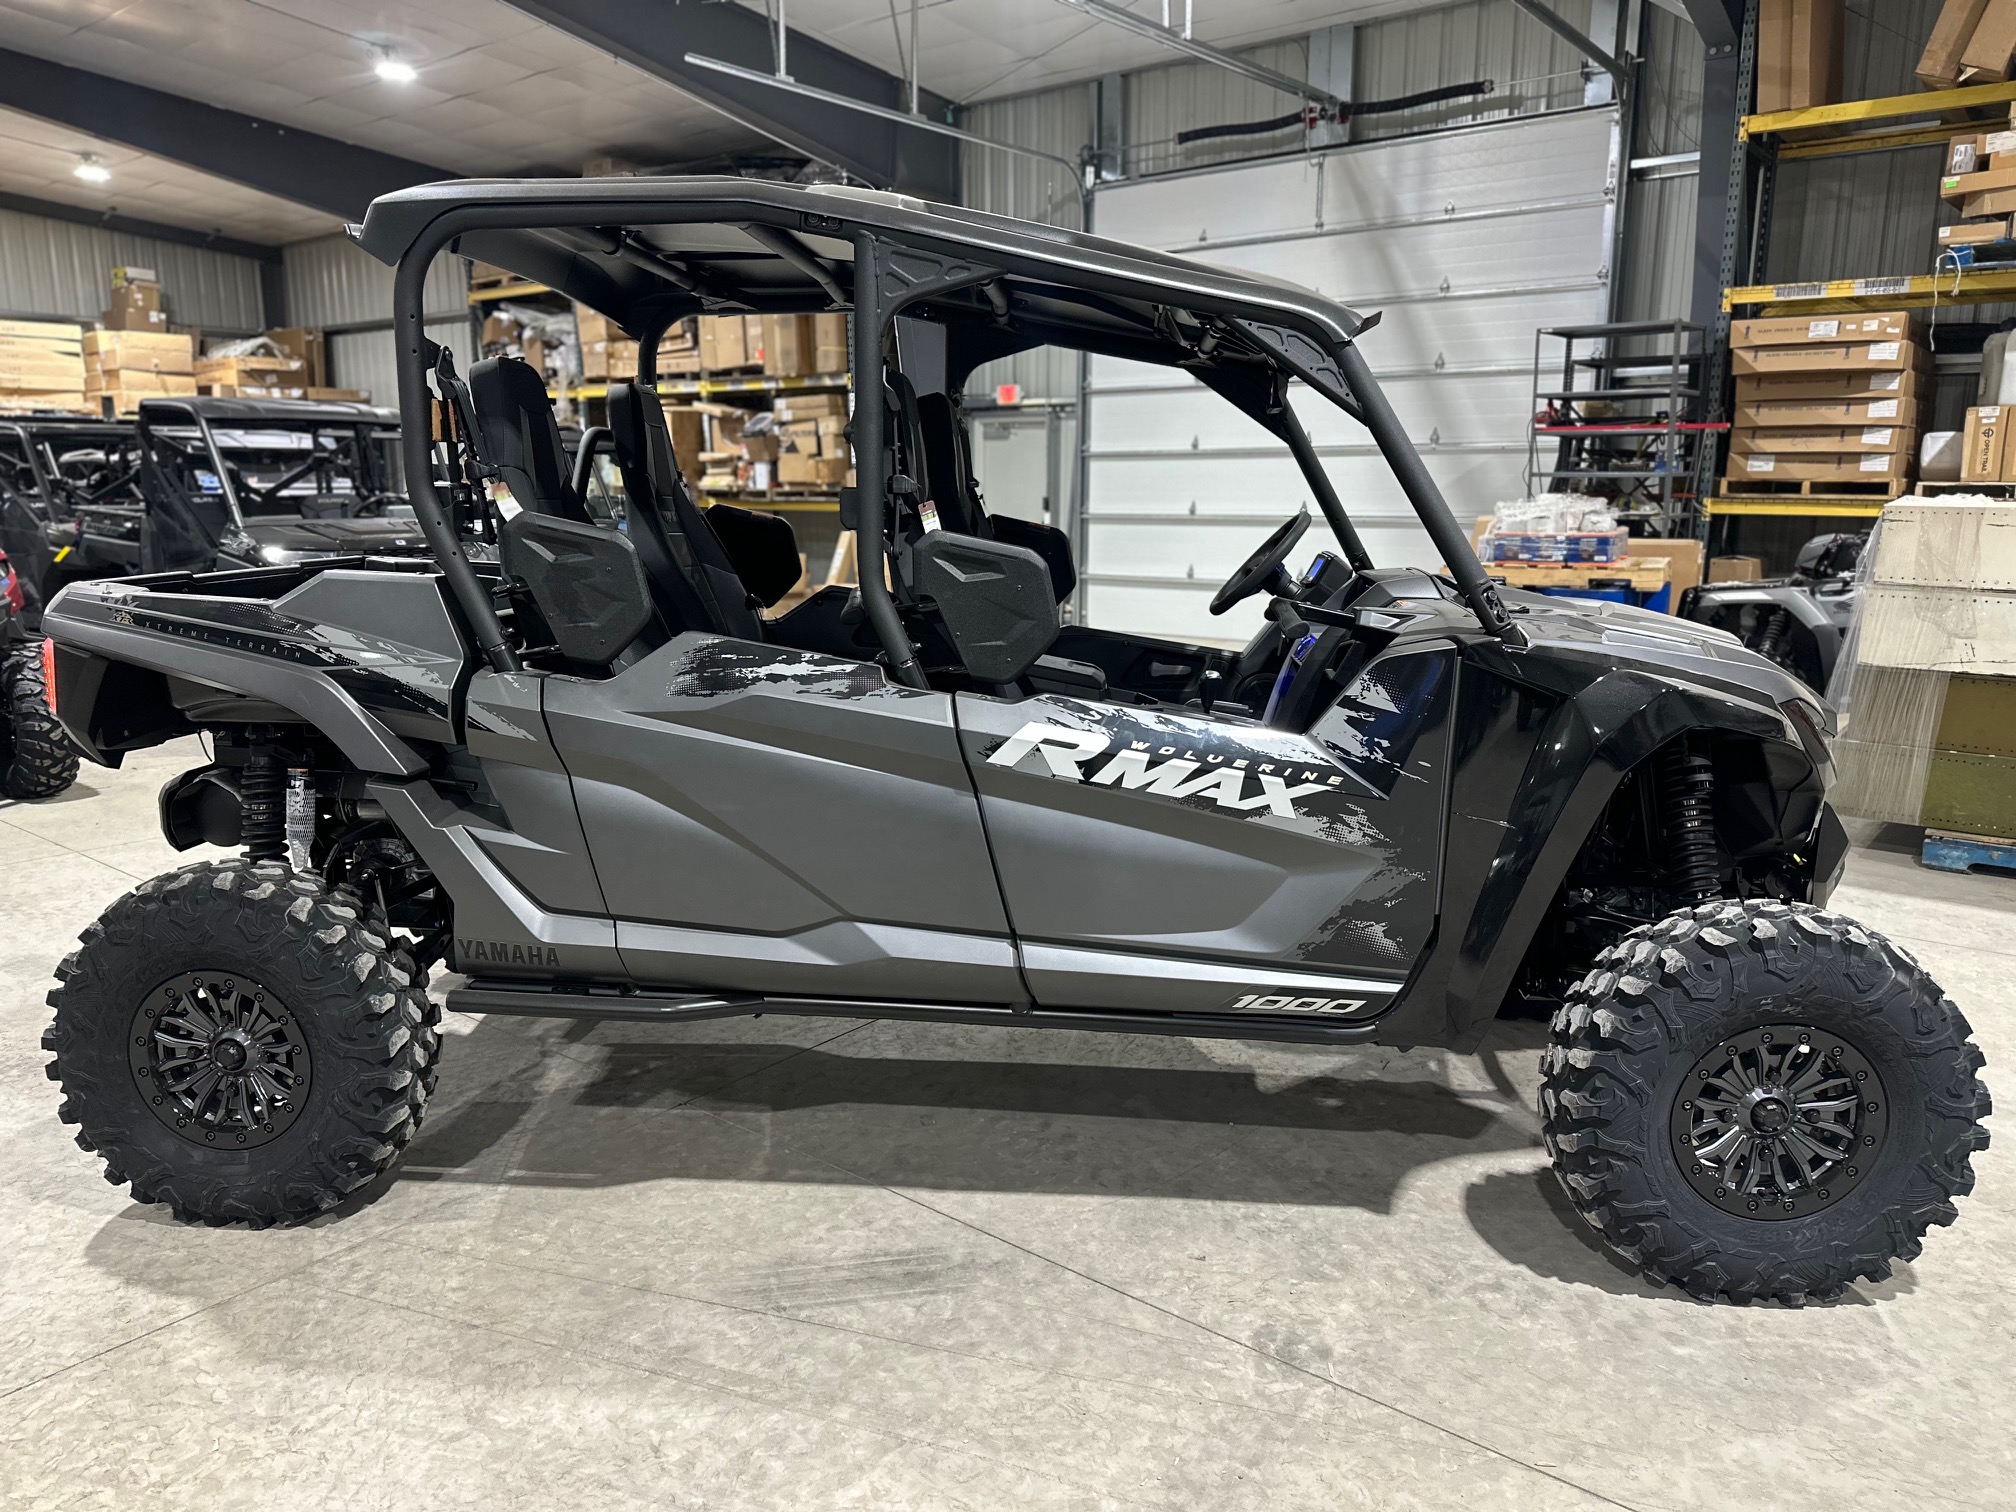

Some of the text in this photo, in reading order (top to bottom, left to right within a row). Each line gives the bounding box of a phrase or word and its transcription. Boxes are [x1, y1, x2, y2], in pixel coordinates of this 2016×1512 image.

[1983, 439, 1991, 456] OPEN
[145, 621, 301, 658] XTREME TERRAIN
[985, 721, 1335, 820] RMAX
[1130, 740, 1344, 785] WOLVERINE
[457, 939, 562, 967] YAMAHA
[1232, 994, 1367, 1014] 1000
